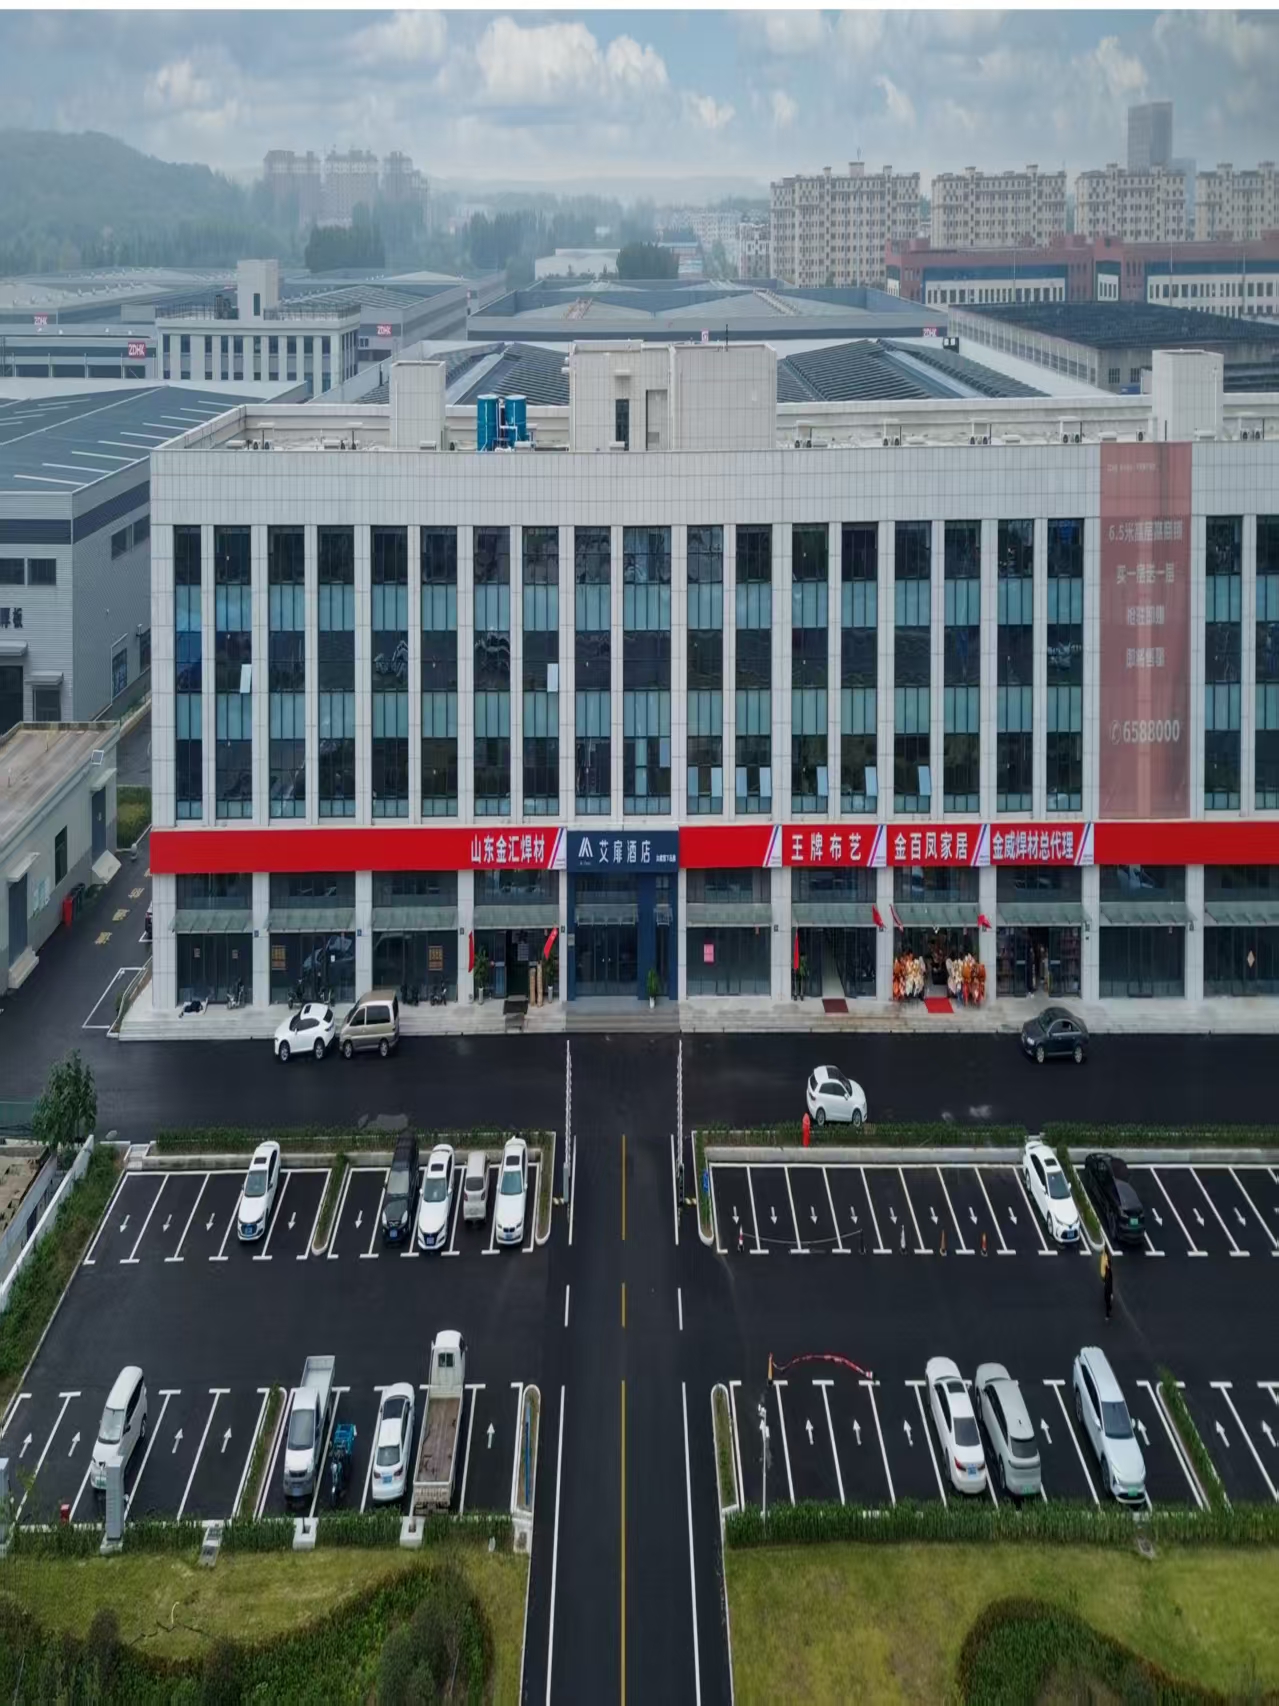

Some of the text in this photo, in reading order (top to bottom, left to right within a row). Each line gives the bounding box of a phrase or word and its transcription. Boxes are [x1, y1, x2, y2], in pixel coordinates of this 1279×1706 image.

[1123, 719, 1180, 742] 6588000
[471, 834, 545, 863] 山东金汇焊材
[599, 840, 651, 864] 艾扉酒店
[791, 832, 862, 861] 王牌布艺
[894, 831, 968, 860] 金百凤家居
[992, 830, 1074, 860] 金威焊材总代理
